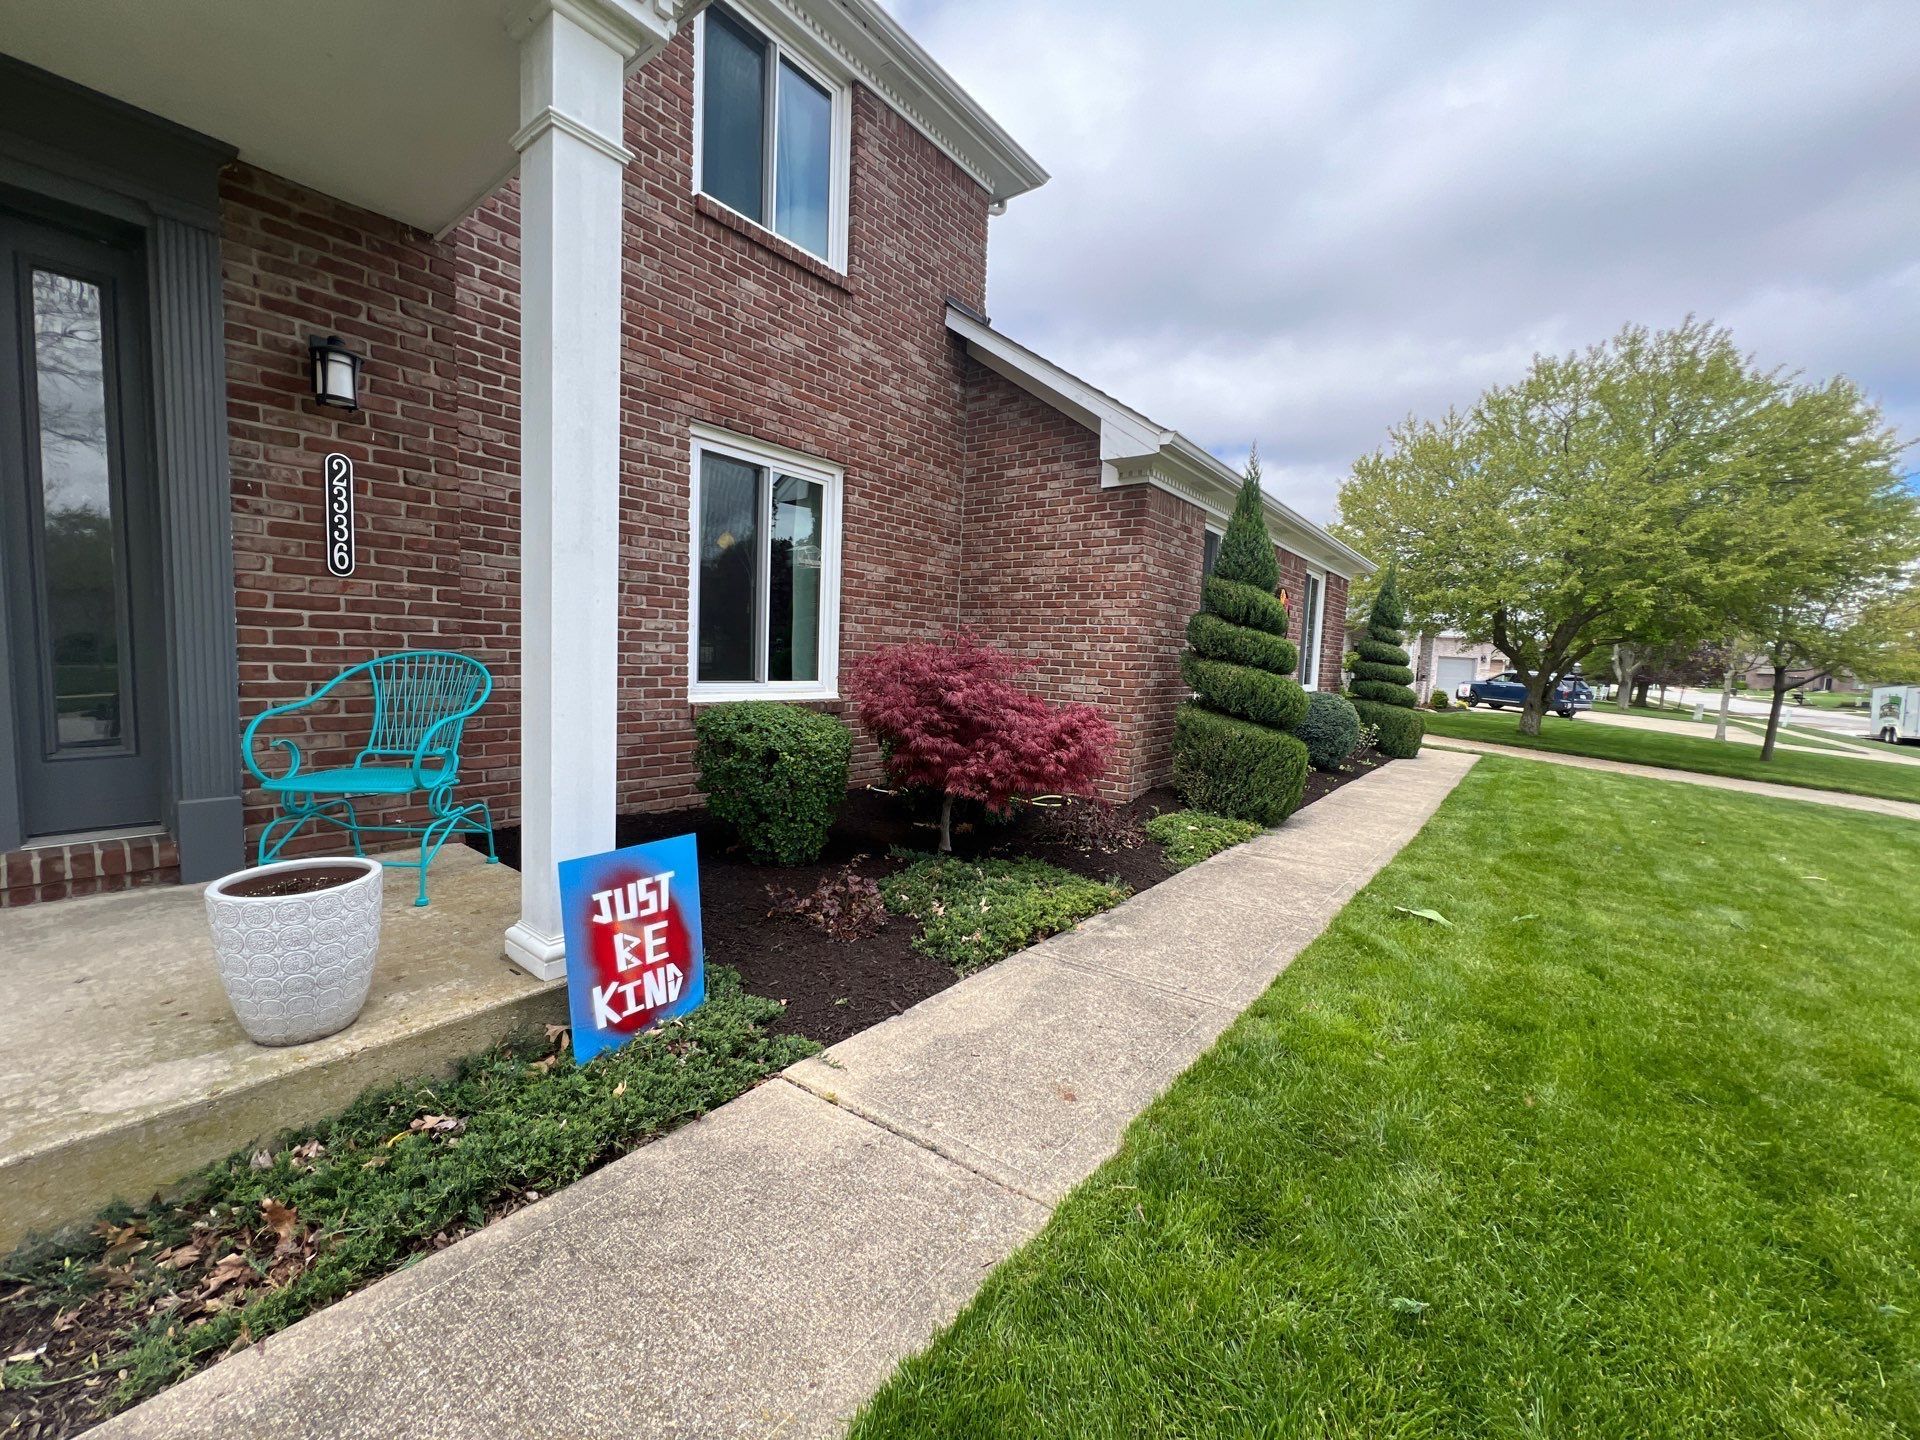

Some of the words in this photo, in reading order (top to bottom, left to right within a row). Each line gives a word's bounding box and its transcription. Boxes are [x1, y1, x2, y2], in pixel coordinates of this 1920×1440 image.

[332, 459, 349, 569] 2336
[592, 870, 675, 924] JUST
[613, 920, 670, 973] BE
[592, 963, 684, 1029] KIND
